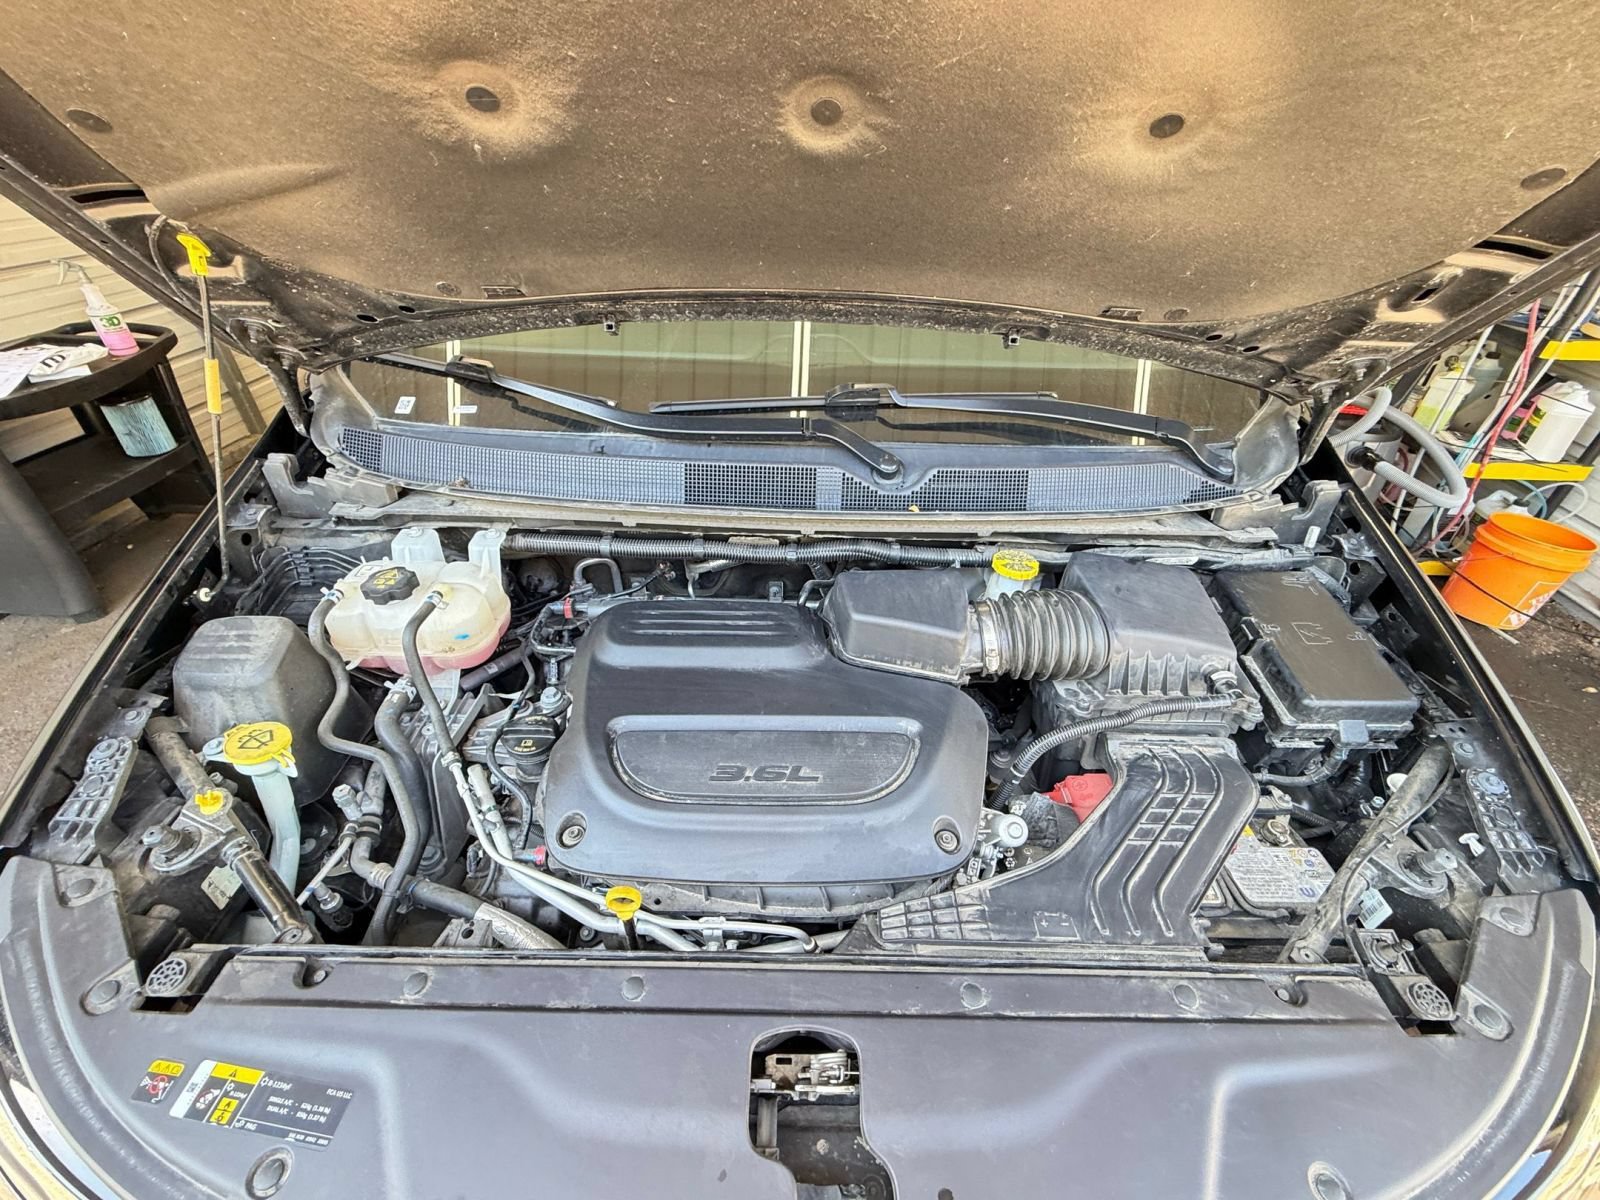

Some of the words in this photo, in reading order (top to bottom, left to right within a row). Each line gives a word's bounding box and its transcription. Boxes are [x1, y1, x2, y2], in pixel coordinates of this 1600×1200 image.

[100, 315, 121, 328] 3D
[708, 763, 822, 783] 3.6L
[244, 1122, 258, 1131] PAG
